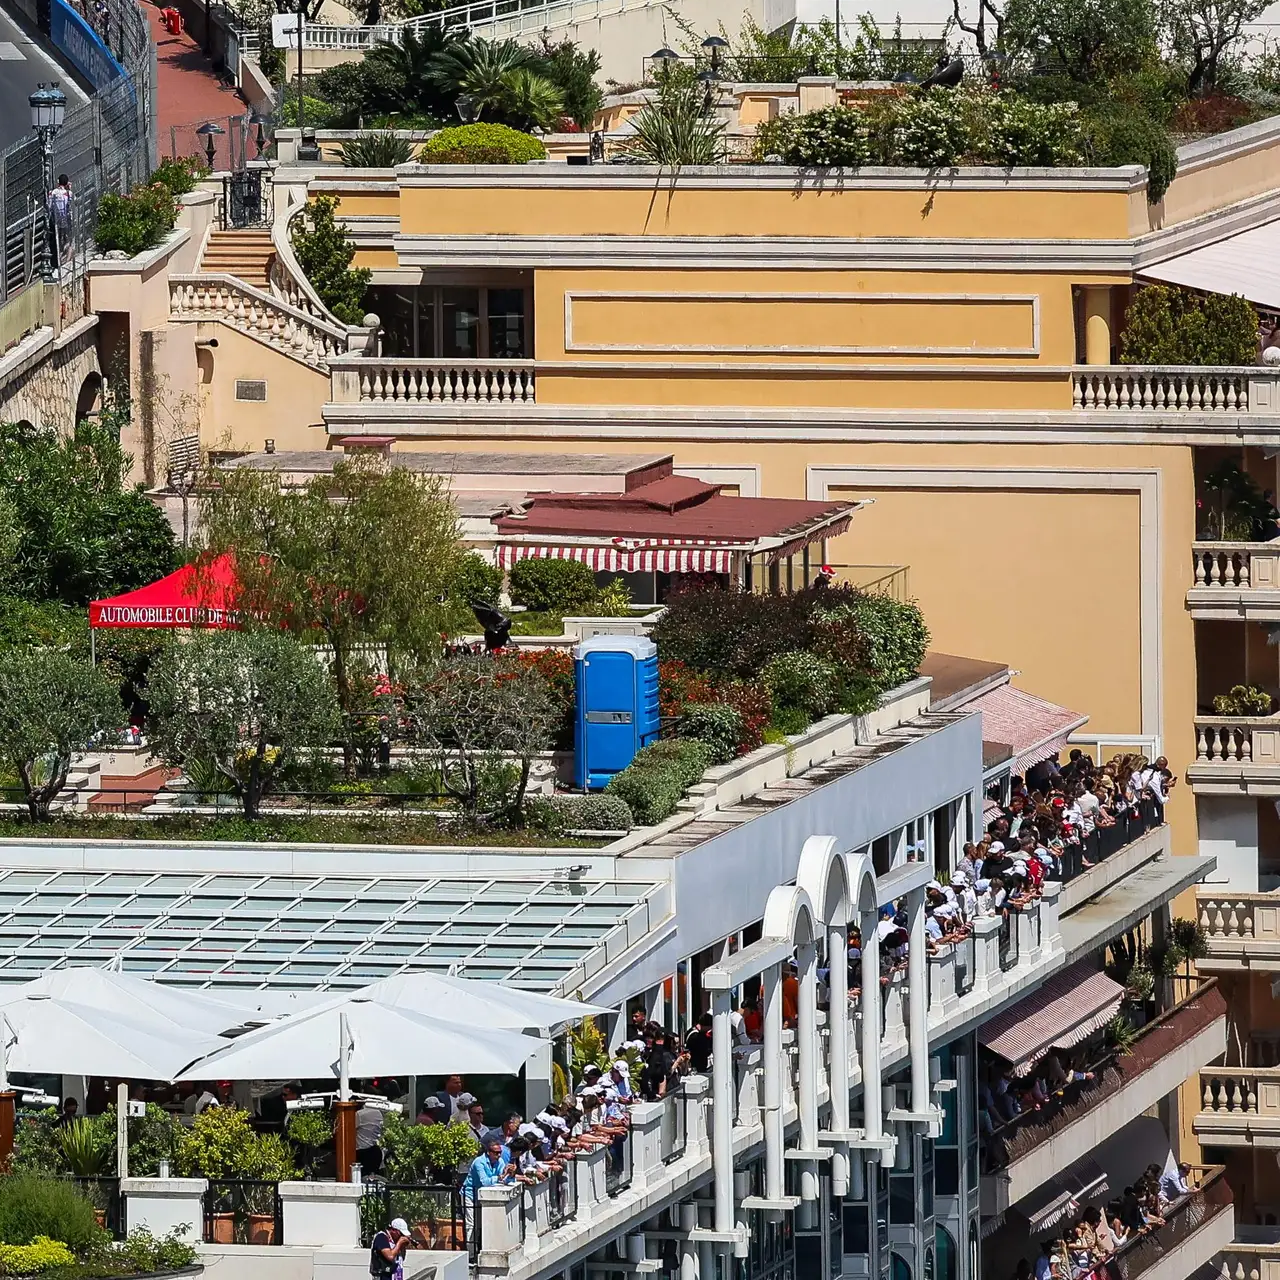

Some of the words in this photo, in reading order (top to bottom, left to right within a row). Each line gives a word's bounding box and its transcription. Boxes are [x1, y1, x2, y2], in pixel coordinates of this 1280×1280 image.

[99, 607, 173, 623] AUTOMOBILE
[175, 607, 205, 623] CLUB
[207, 608, 223, 624] DE
